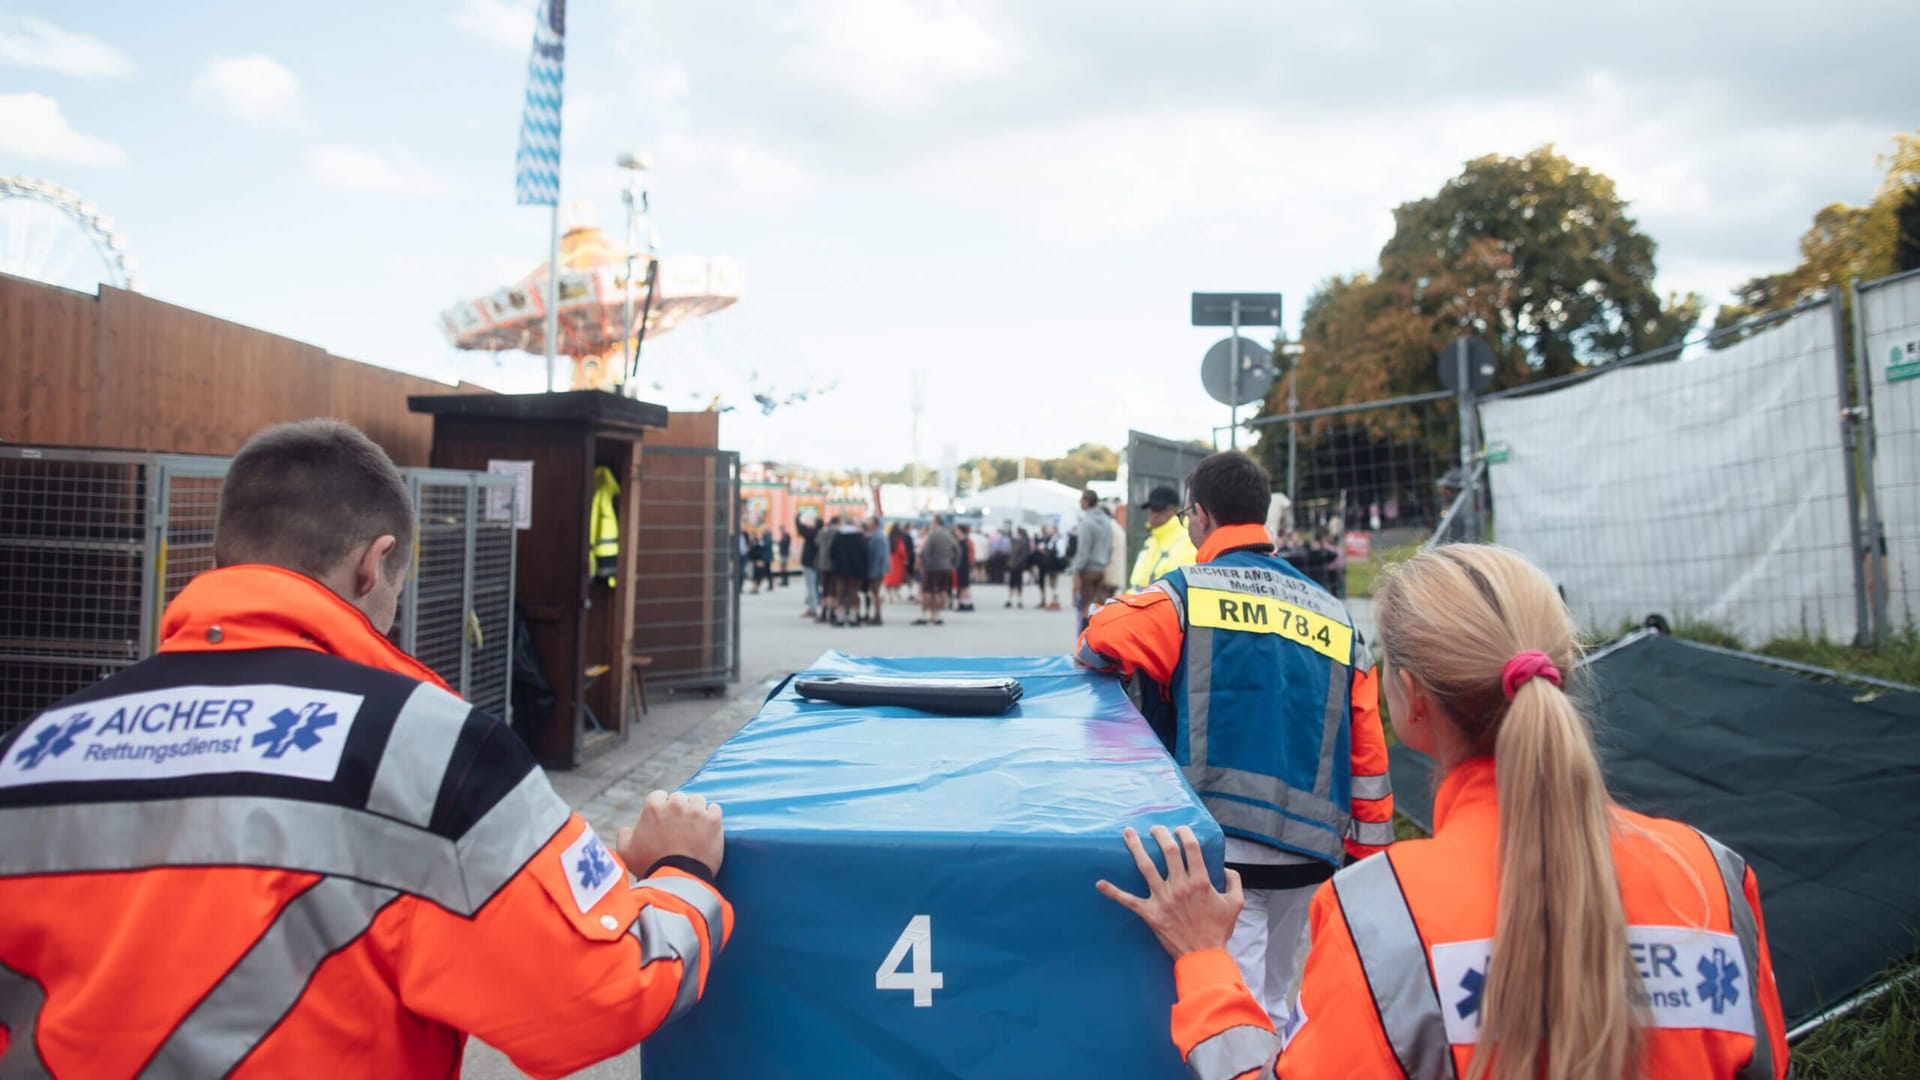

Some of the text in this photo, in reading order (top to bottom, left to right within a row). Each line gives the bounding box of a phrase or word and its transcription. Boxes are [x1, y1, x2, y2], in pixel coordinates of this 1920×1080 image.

[1189, 567, 1240, 579] AICHER
[1219, 598, 1331, 647] RM 78.4
[96, 699, 254, 736] AICHER
[84, 735, 242, 764] Rettungsdienst
[876, 914, 943, 1007] 4
